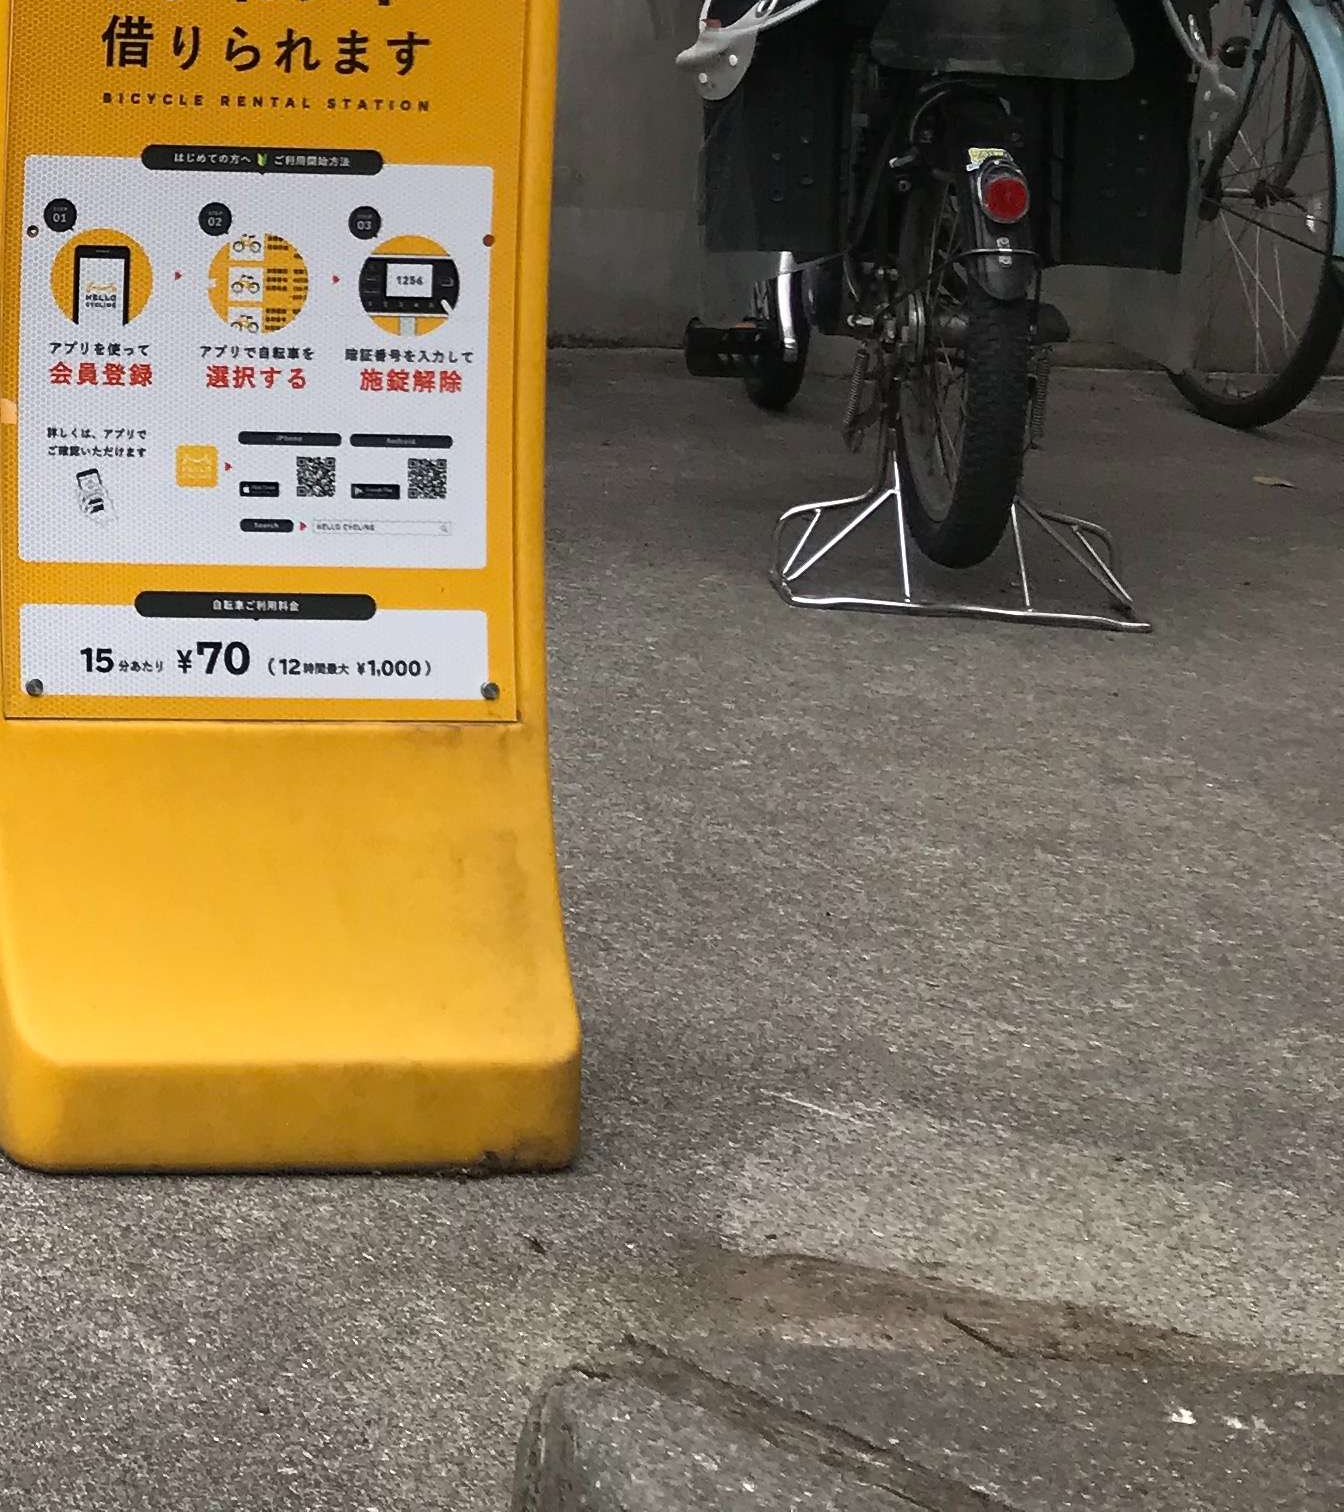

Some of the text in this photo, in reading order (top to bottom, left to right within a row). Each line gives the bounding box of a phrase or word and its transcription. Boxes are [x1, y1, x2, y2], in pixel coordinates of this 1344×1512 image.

[101, 14, 431, 76] 借りられます
[102, 92, 430, 112] BICYCLE RENTAL STATION
[173, 152, 351, 168] はじめての方へ ご利用開始方法
[52, 213, 67, 223] 01
[207, 217, 223, 227] 02
[356, 220, 372, 230] 03
[85, 293, 117, 301] HELLO
[49, 341, 150, 357] アプリを使って
[200, 344, 314, 361] アプリで自転車を
[345, 348, 474, 364] 暗証番号を入力して
[49, 360, 153, 387] 会員登録
[206, 364, 307, 390] 選択する
[359, 368, 463, 393] 施錠解除
[47, 427, 148, 439] 詳しくは、アプリで
[48, 445, 148, 458] ご確認いただけます
[213, 599, 300, 613] 自転車ご利用料金
[176, 641, 251, 676] ¥70
